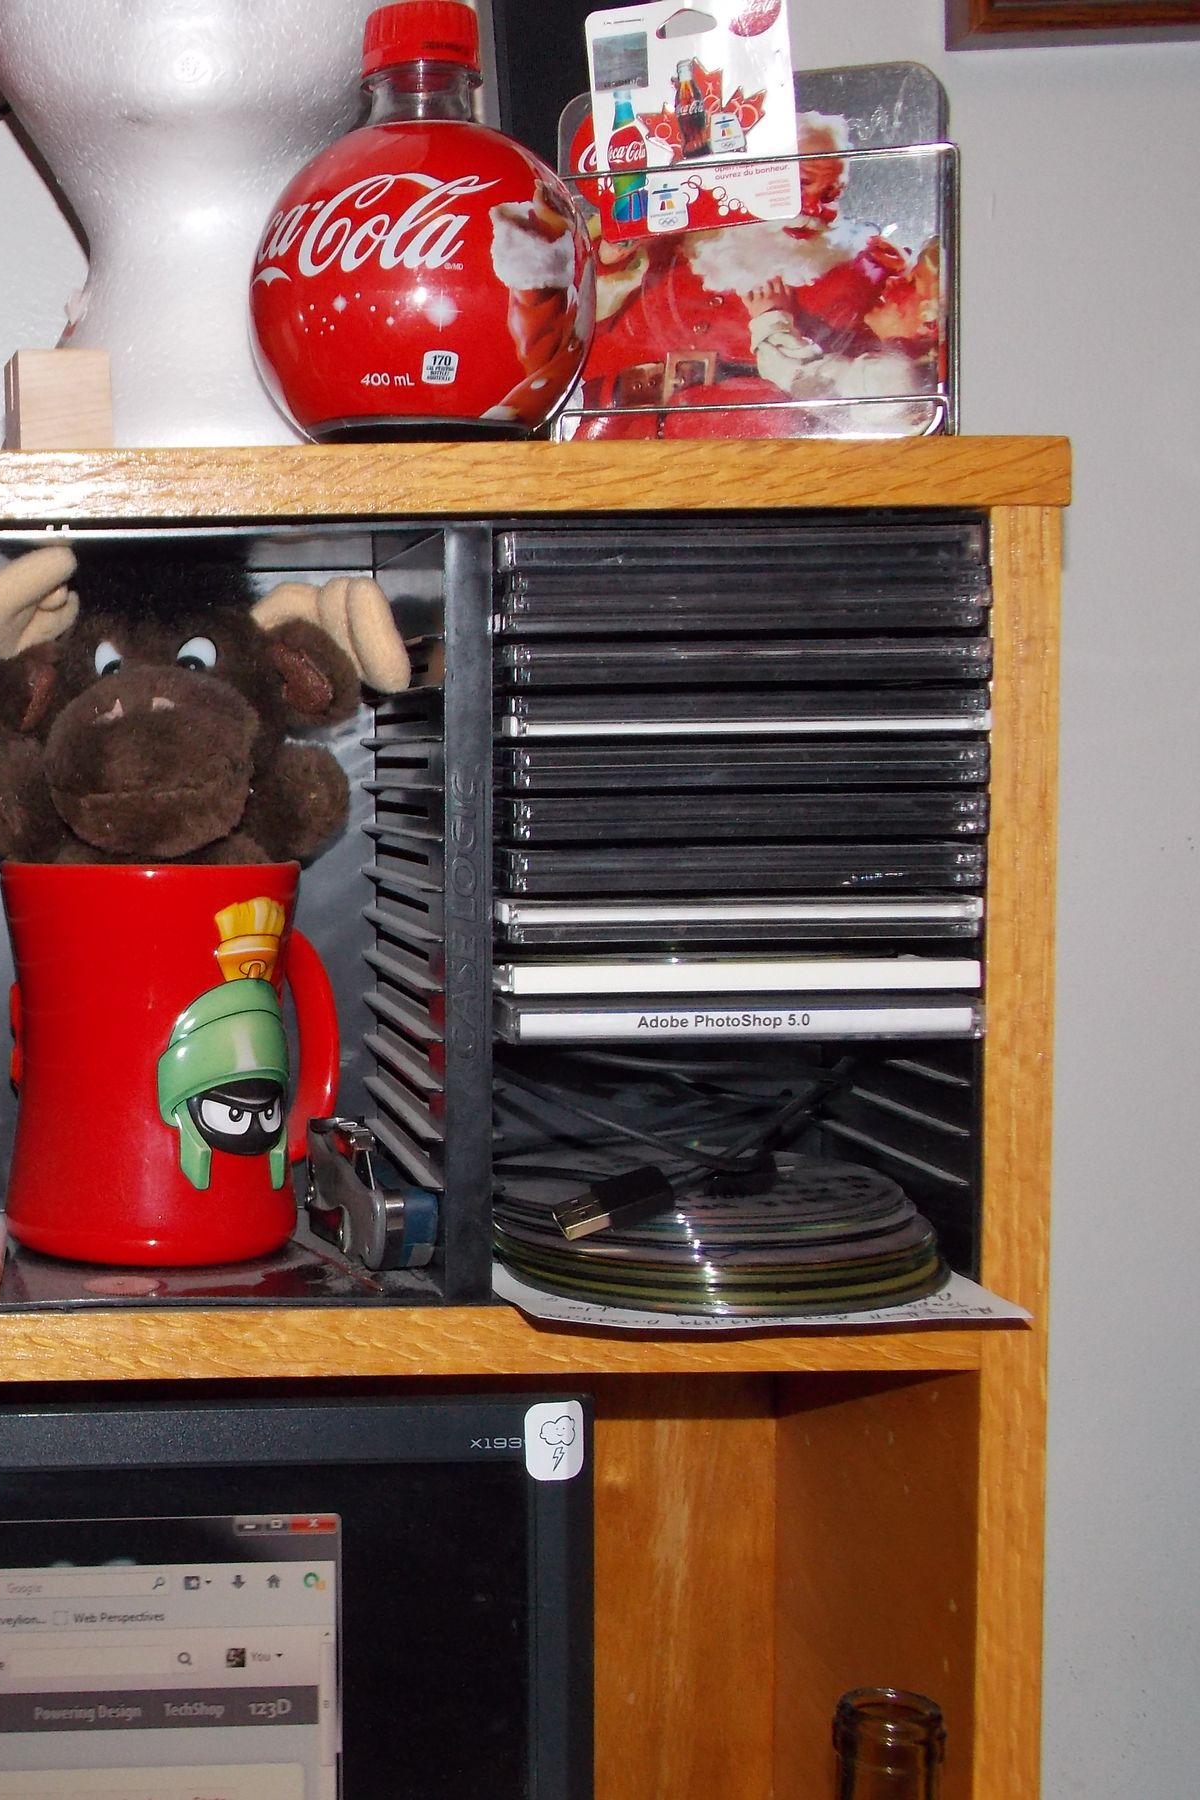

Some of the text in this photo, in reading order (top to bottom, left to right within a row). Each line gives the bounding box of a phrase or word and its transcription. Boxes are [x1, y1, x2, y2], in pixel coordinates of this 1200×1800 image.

[743, 168, 754, 177] du
[432, 354, 452, 366] 170
[360, 372, 416, 387] 400 mL
[637, 1013, 811, 1030] Adobe PhotoShop 5.0
[469, 1437, 525, 1450] X193
[73, 1609, 165, 1625] Web Perspectives
[251, 1650, 271, 1664] You
[34, 1703, 142, 1722] Powering Design
[164, 1701, 225, 1718] TechShop
[248, 1697, 293, 1718] 123D
